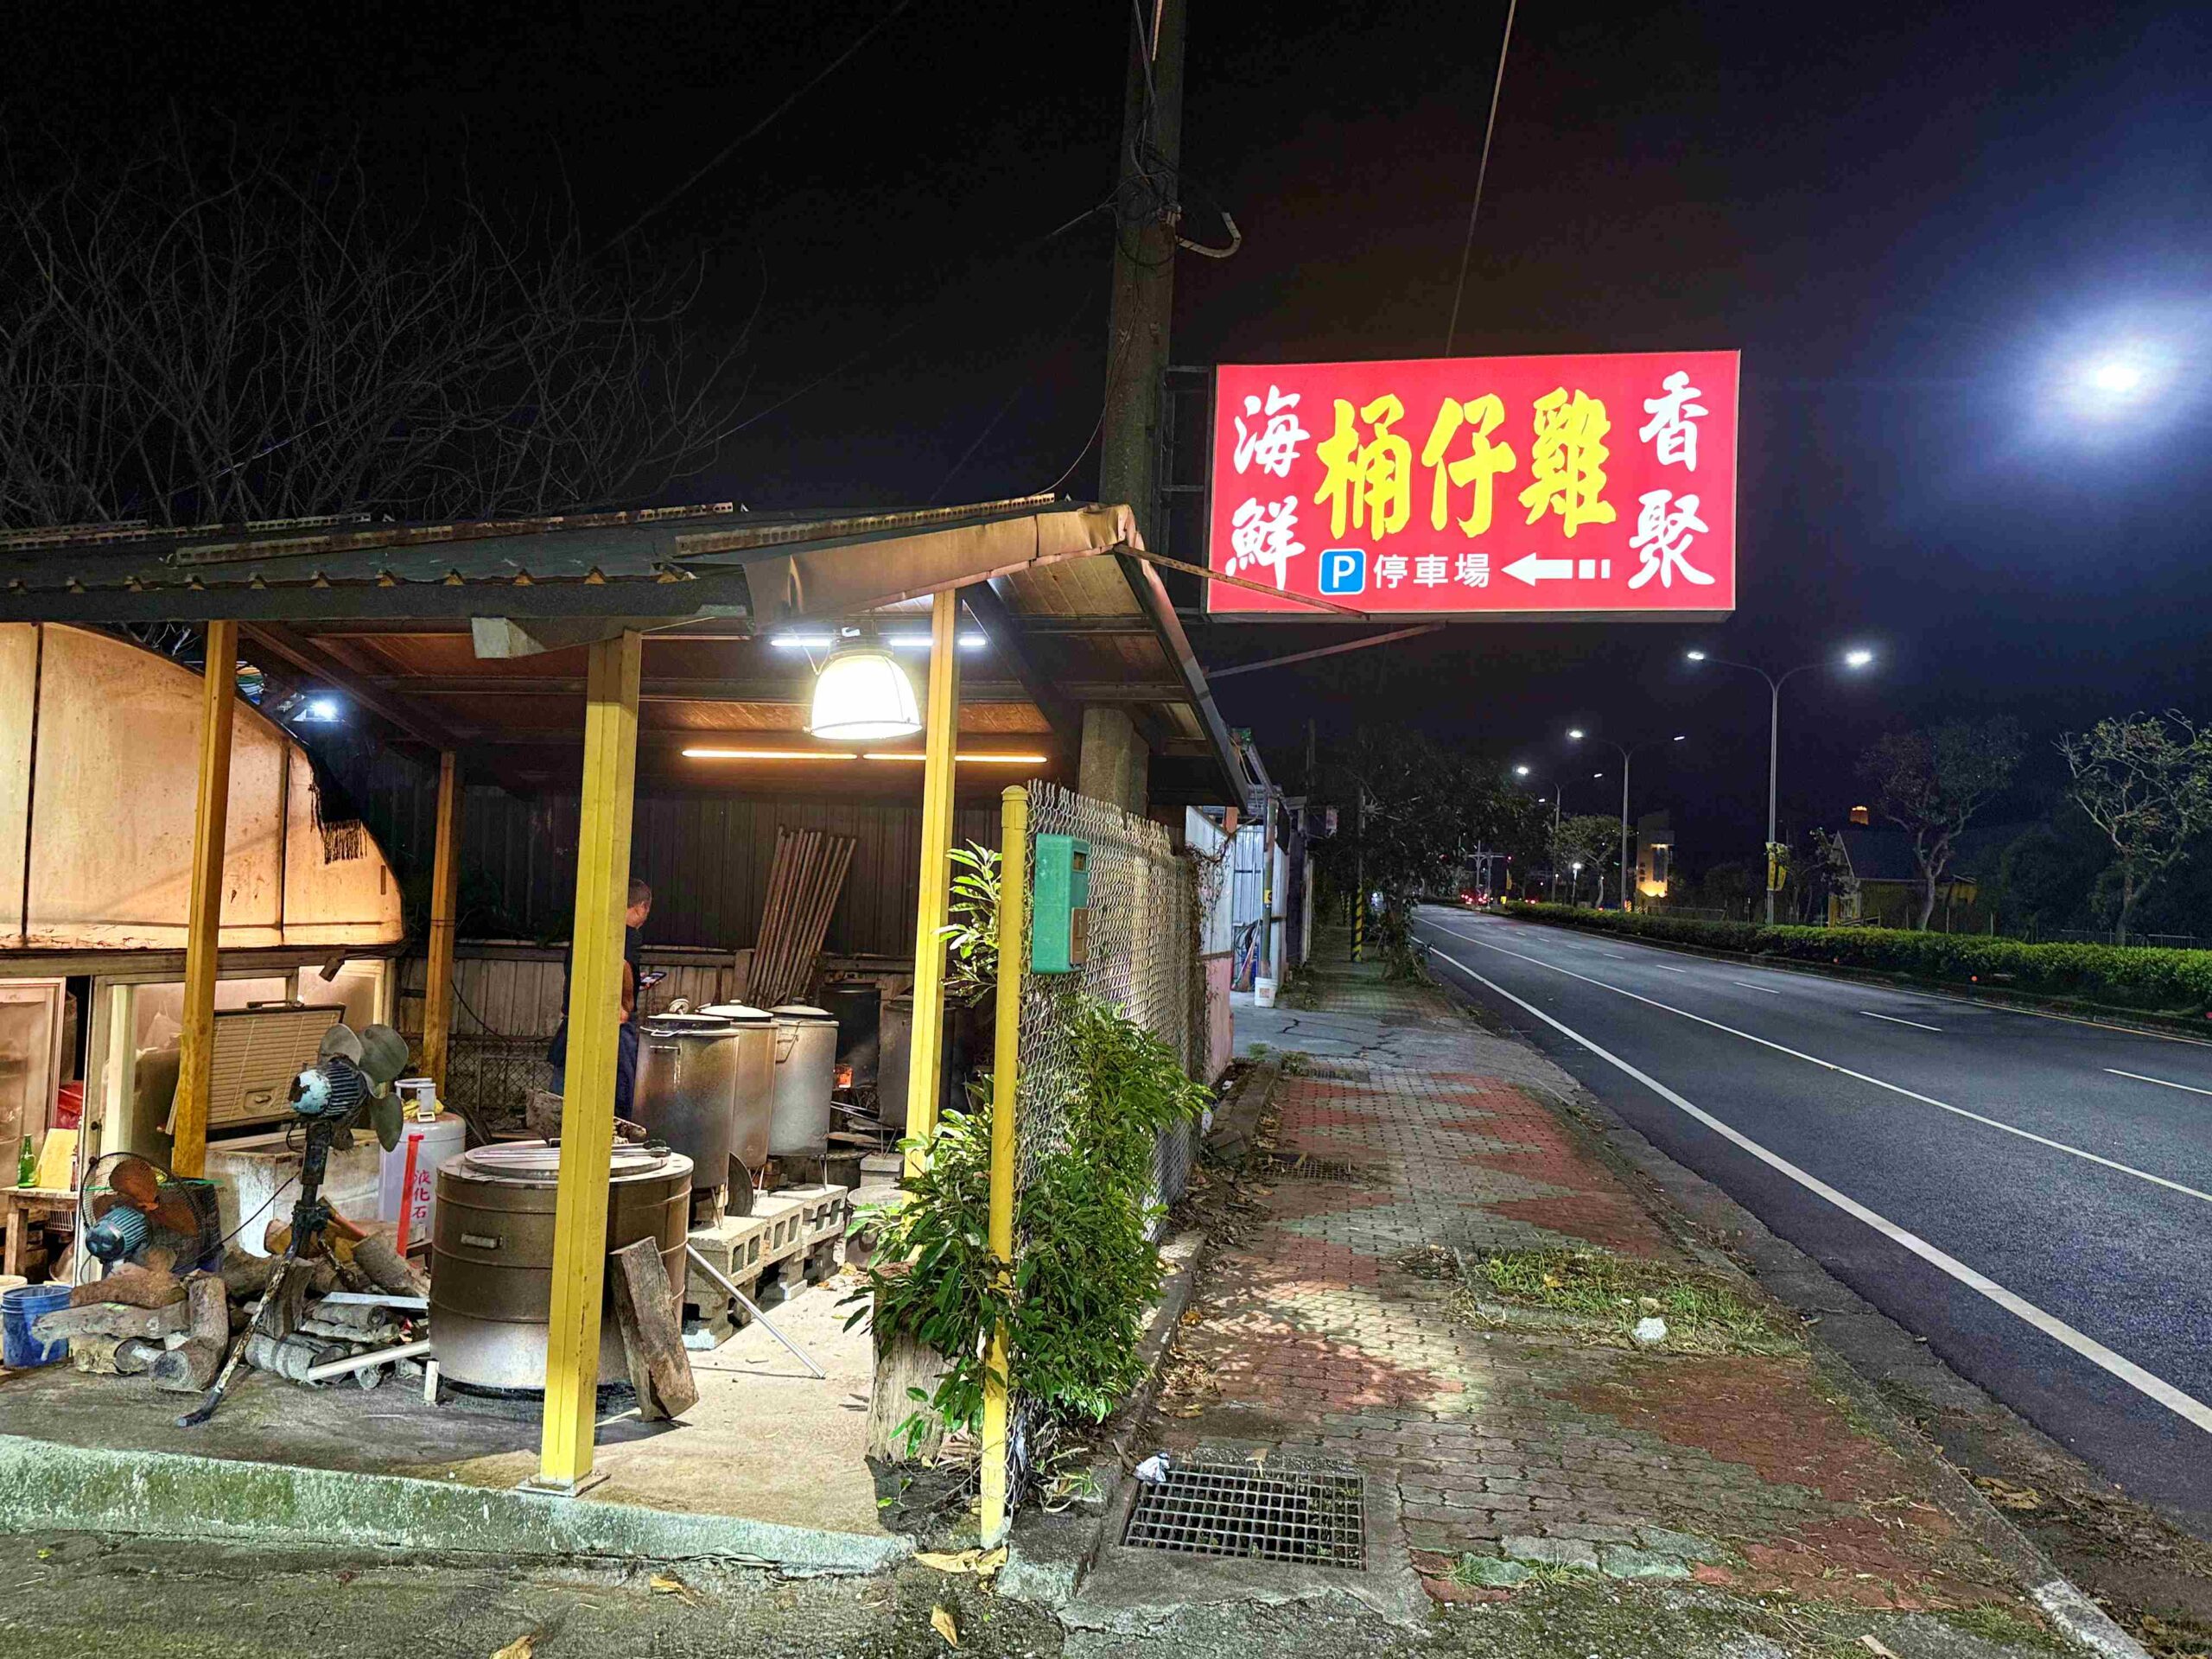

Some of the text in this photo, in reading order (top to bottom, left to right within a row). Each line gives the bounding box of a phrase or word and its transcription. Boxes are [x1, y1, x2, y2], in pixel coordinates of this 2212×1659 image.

[1225, 385, 1311, 591] 海鮮
[1313, 386, 1617, 542] 桶仔雞
[1628, 371, 1715, 589] 香聚
[1373, 553, 1491, 588] 停車場
[412, 1169, 431, 1219] 液化石
